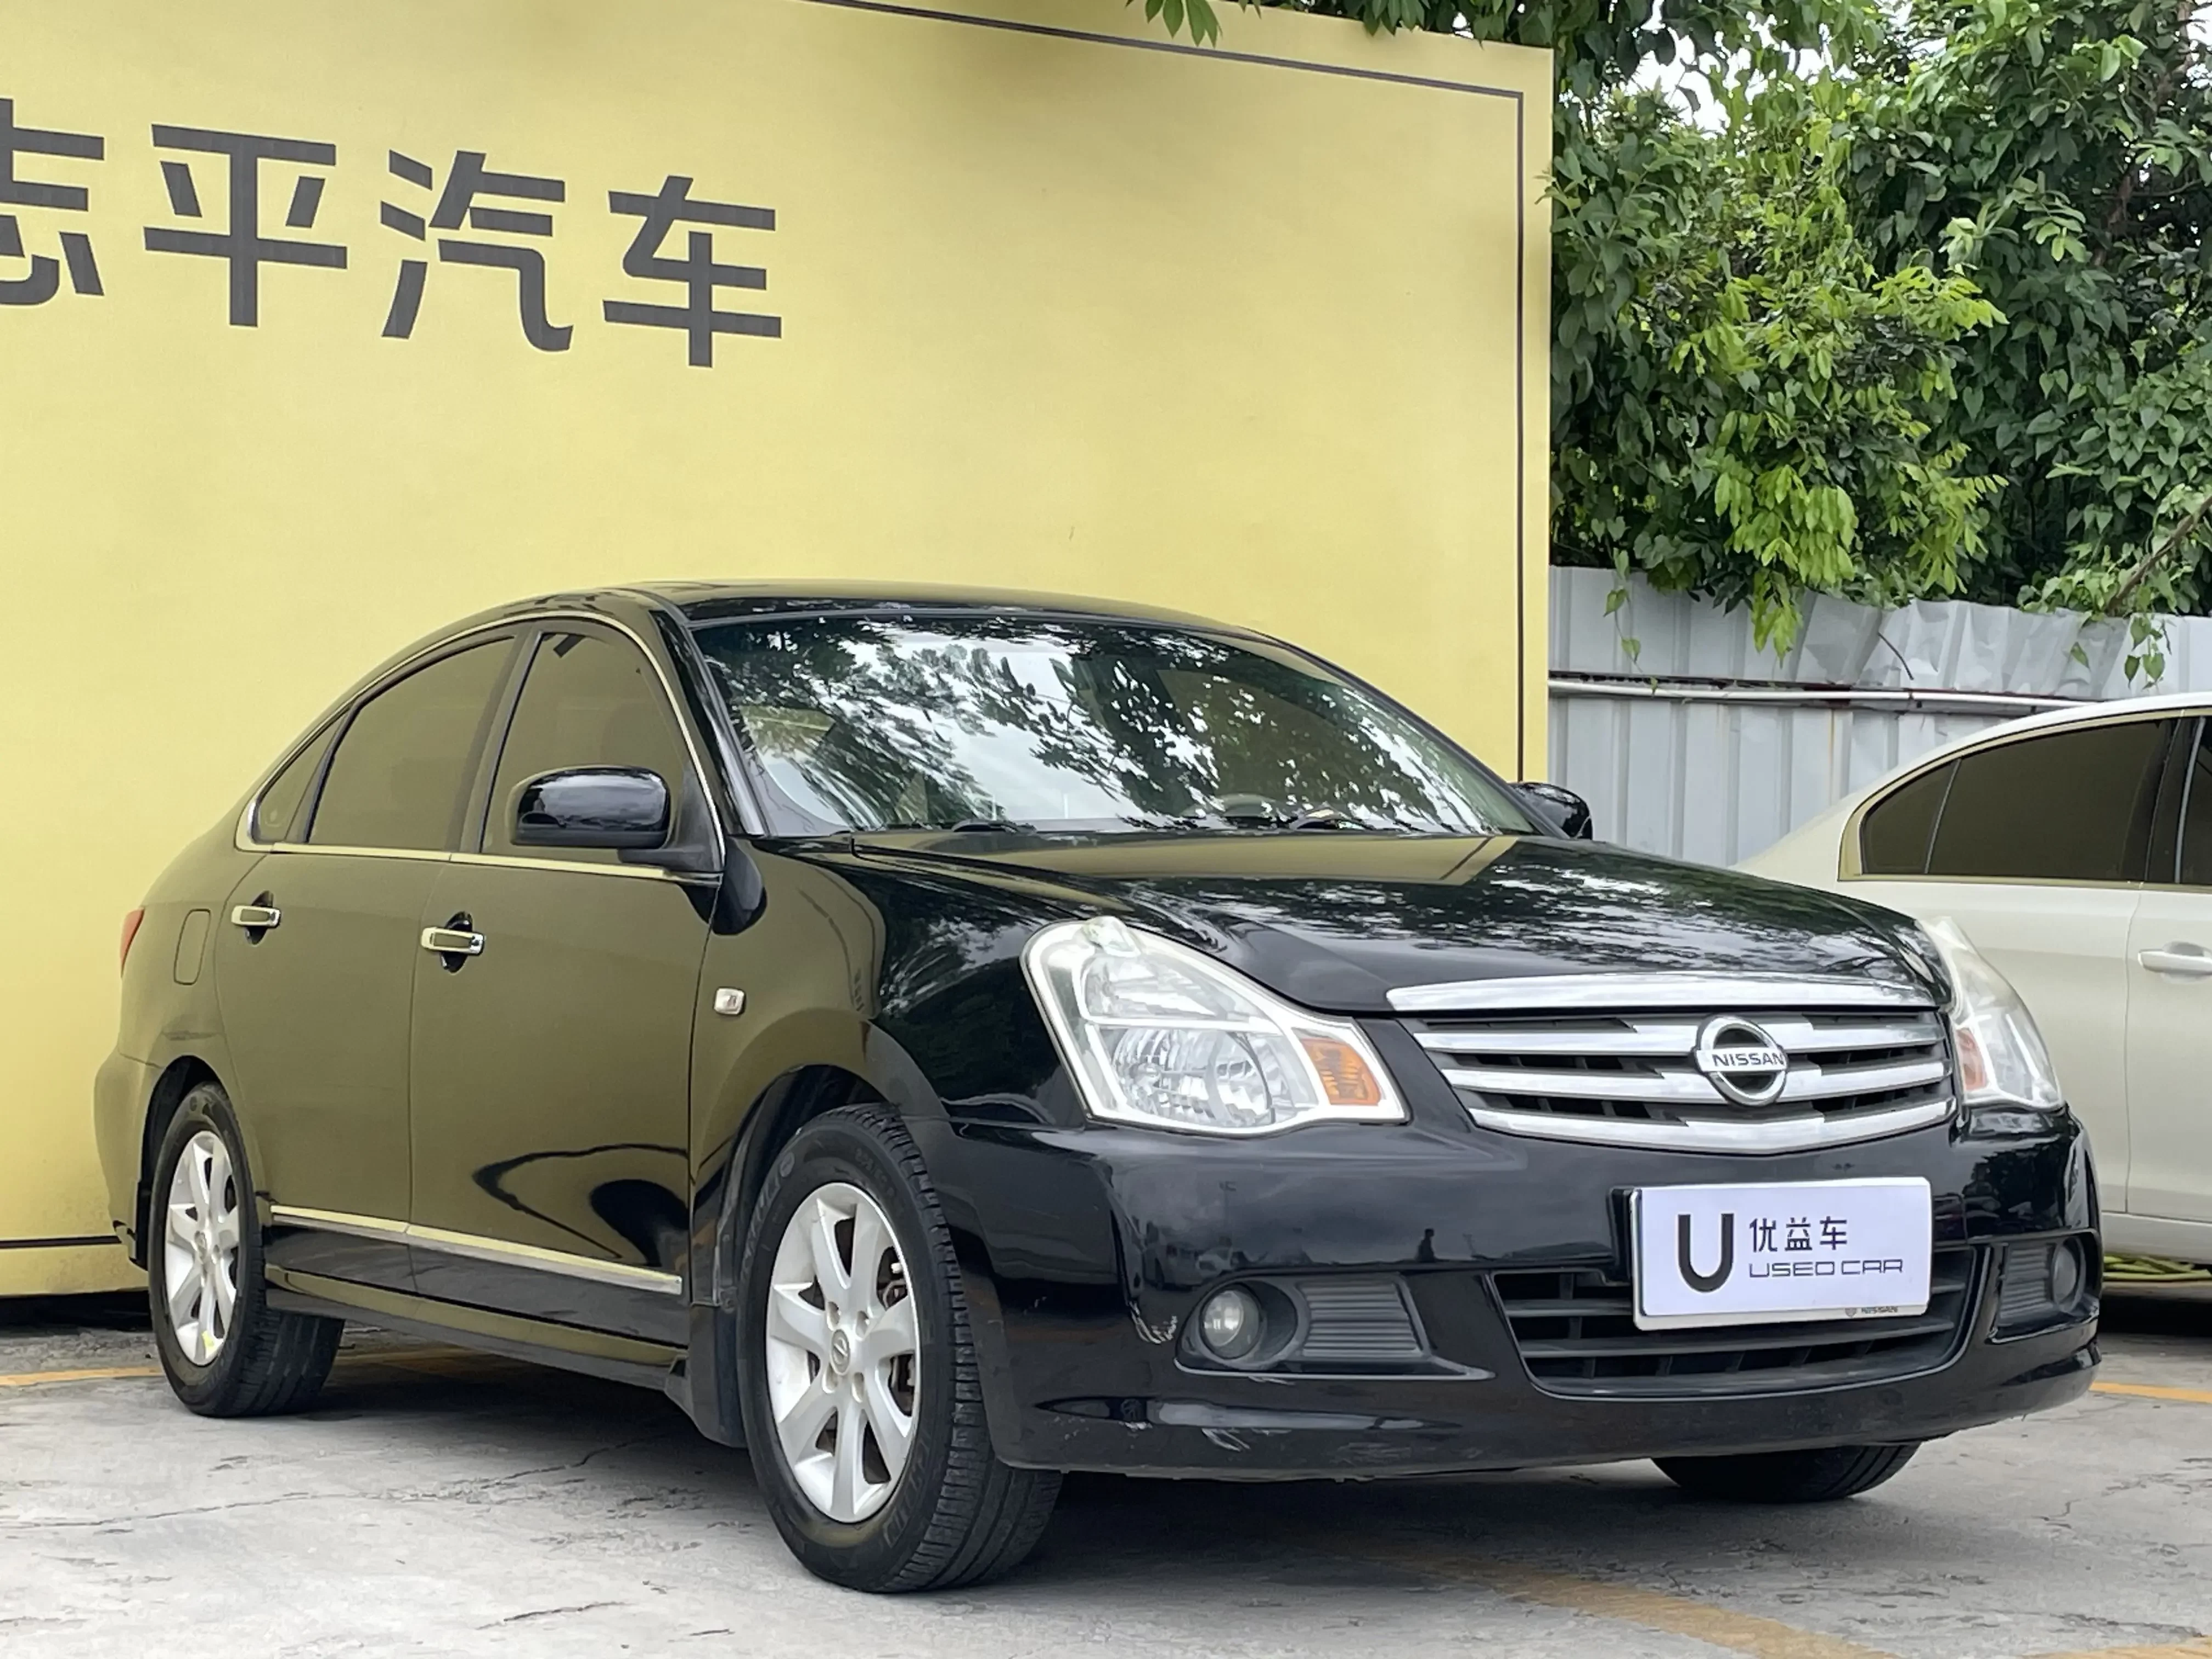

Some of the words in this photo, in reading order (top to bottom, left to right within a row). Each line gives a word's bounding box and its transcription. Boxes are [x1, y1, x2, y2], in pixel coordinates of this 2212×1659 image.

[1711, 1052, 1784, 1067] NISSAN
[1749, 1215, 1848, 1253] 优益车
[1677, 1212, 1734, 1293] U
[1749, 1261, 1835, 1278] USED
[1841, 1259, 1904, 1276] CAR
